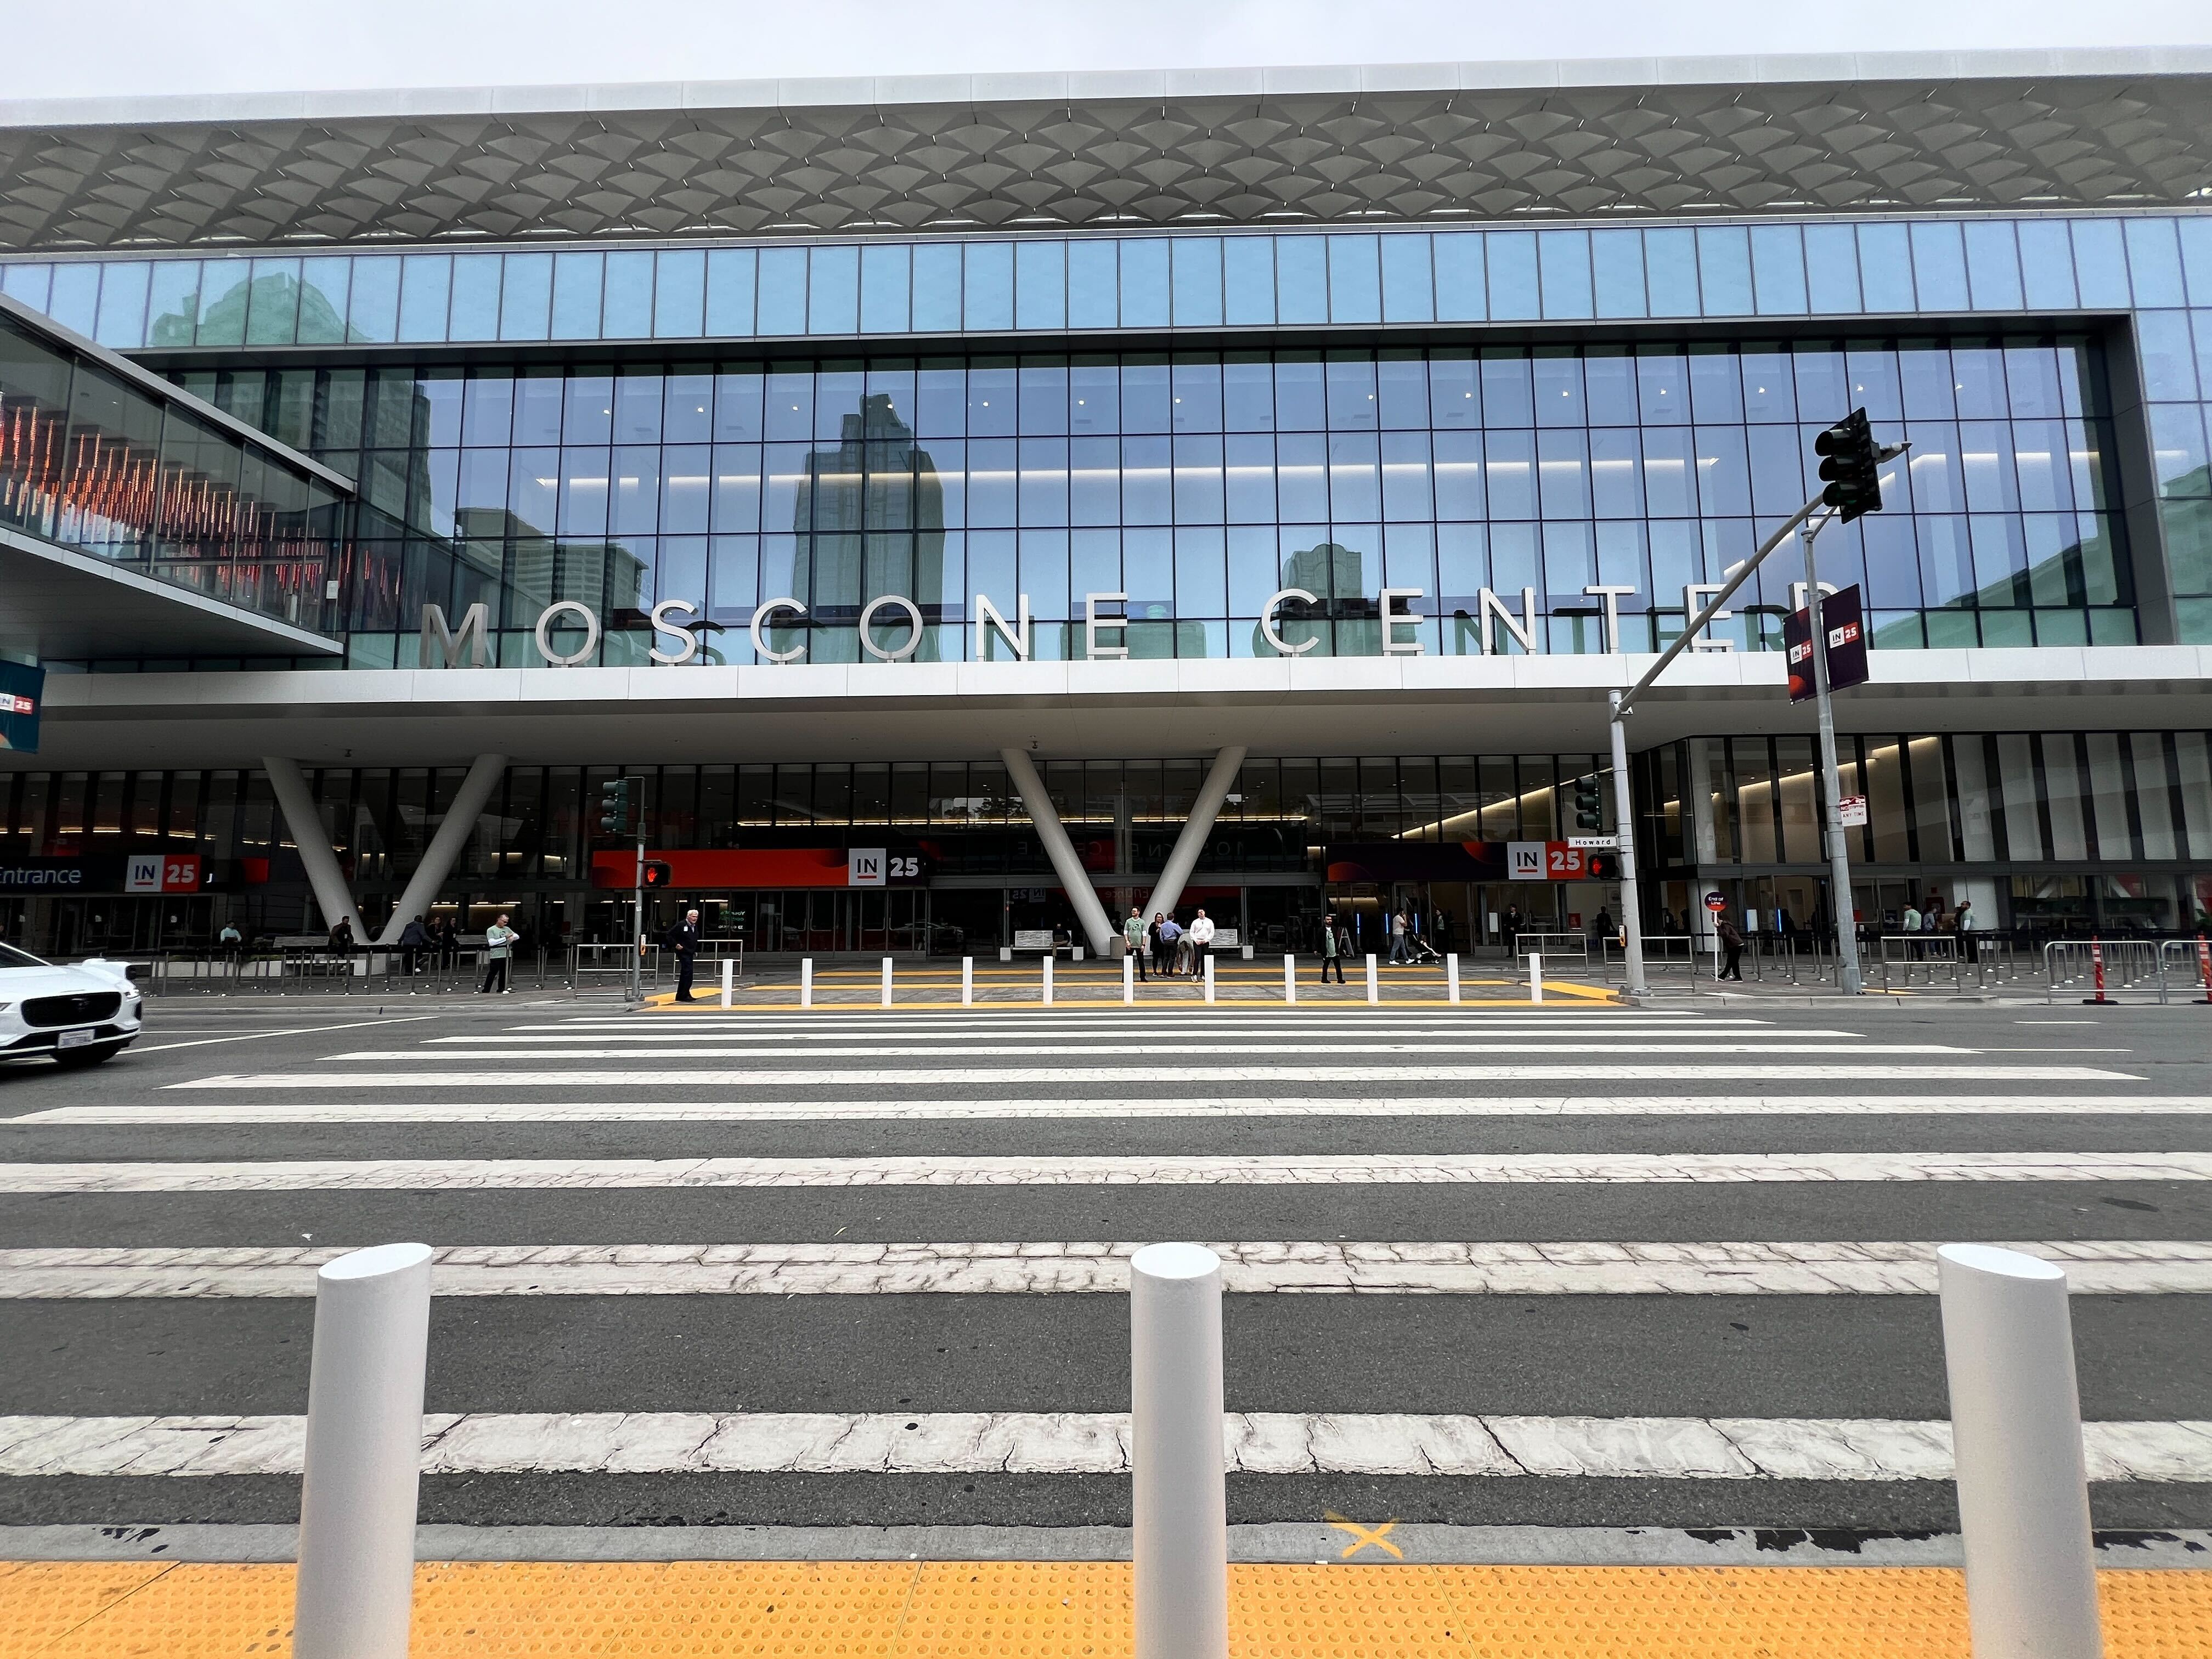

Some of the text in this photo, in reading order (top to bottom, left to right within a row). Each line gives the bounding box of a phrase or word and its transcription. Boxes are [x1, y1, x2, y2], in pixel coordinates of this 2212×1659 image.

[420, 592, 1128, 668] MOSCONE
[1832, 627, 1857, 641] IN 25
[1792, 644, 1811, 658] IN 25
[15, 700, 31, 710] 25
[857, 857, 919, 877] IN 25
[1516, 851, 1580, 871] IN 25
[135, 865, 155, 879] IN
[167, 864, 194, 883] 25
